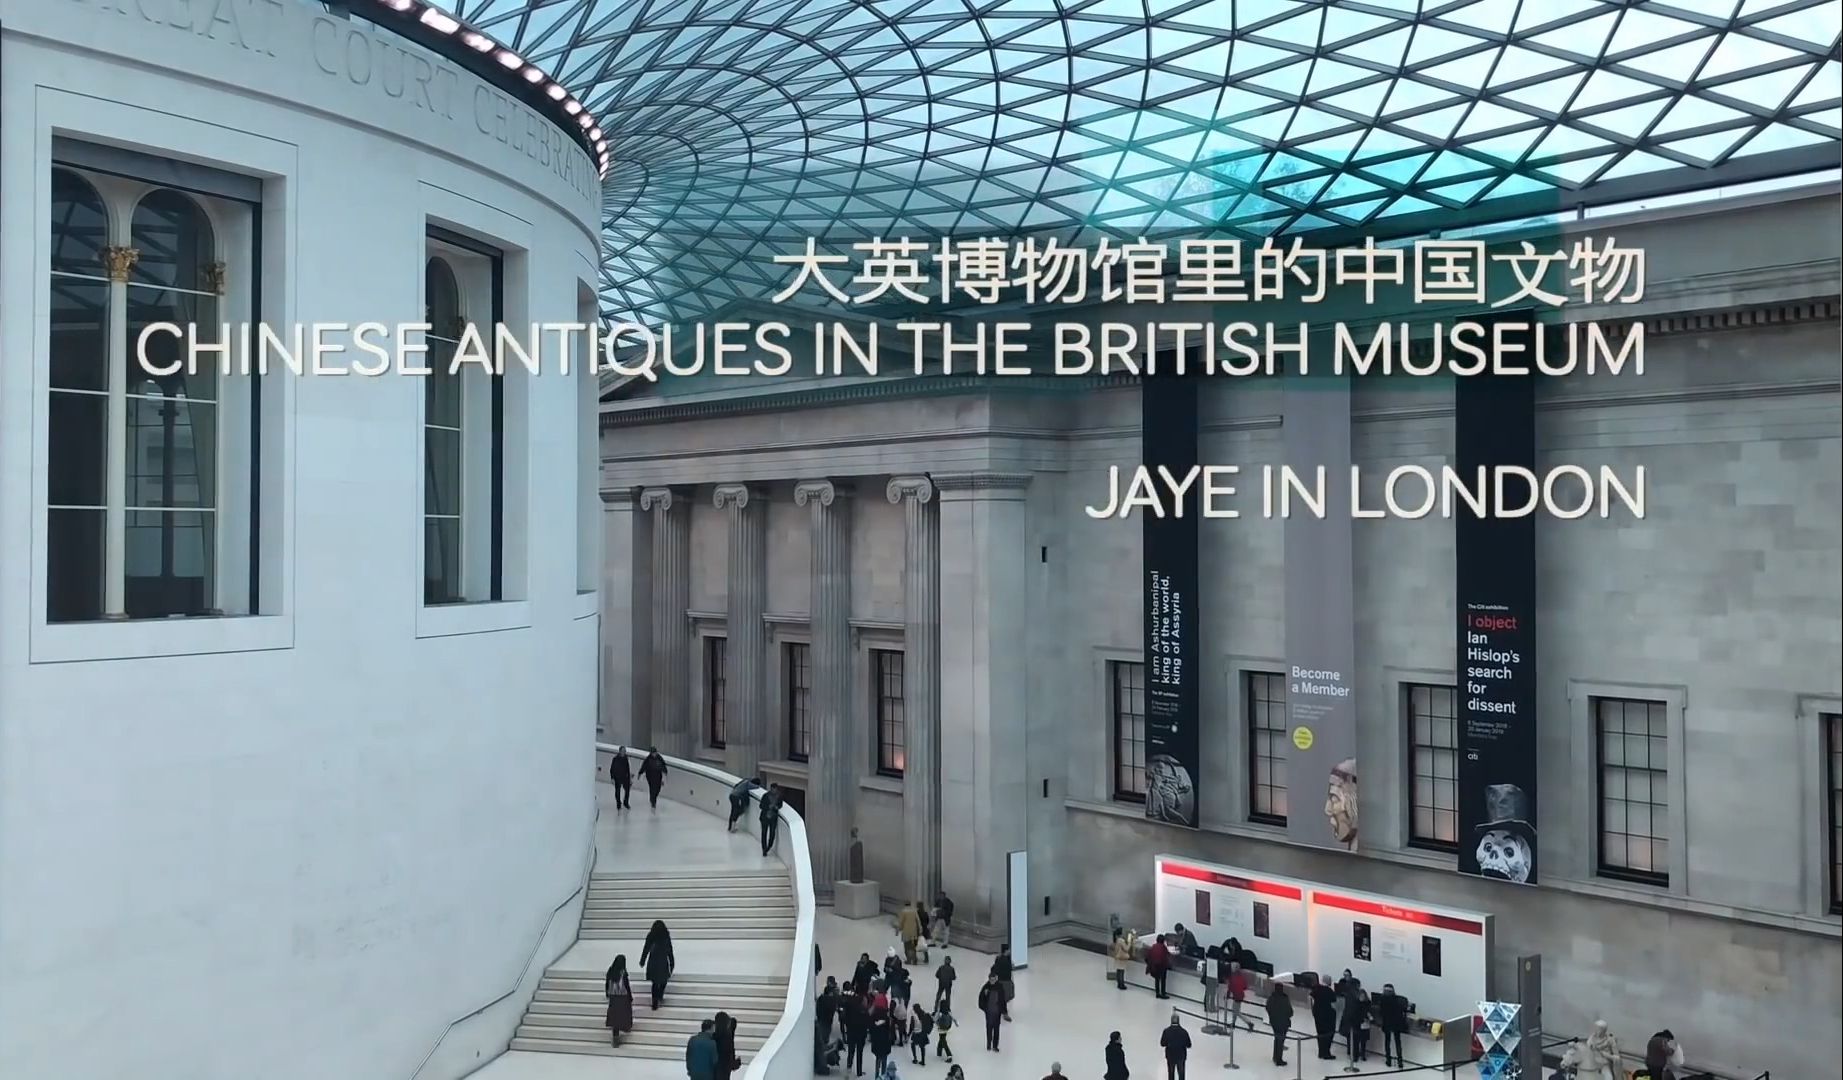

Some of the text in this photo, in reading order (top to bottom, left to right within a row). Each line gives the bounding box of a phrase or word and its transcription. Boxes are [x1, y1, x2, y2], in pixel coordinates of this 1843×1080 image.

[312, 16, 459, 121] COURT
[1150, 570, 1160, 652] Ashurbanipal
[1160, 617, 1170, 637] the
[1475, 615, 1517, 630] object
[1171, 592, 1182, 685] king of Assyria
[1467, 630, 1488, 644] Ian
[1160, 640, 1170, 653] of
[1467, 647, 1520, 664] Hislop's
[1153, 655, 1160, 675] am
[1160, 657, 1171, 684] king
[1292, 665, 1340, 681] Become
[1467, 666, 1512, 679] search
[1291, 681, 1350, 697] a Member
[1467, 680, 1487, 694] for
[1467, 697, 1517, 714] dissent
